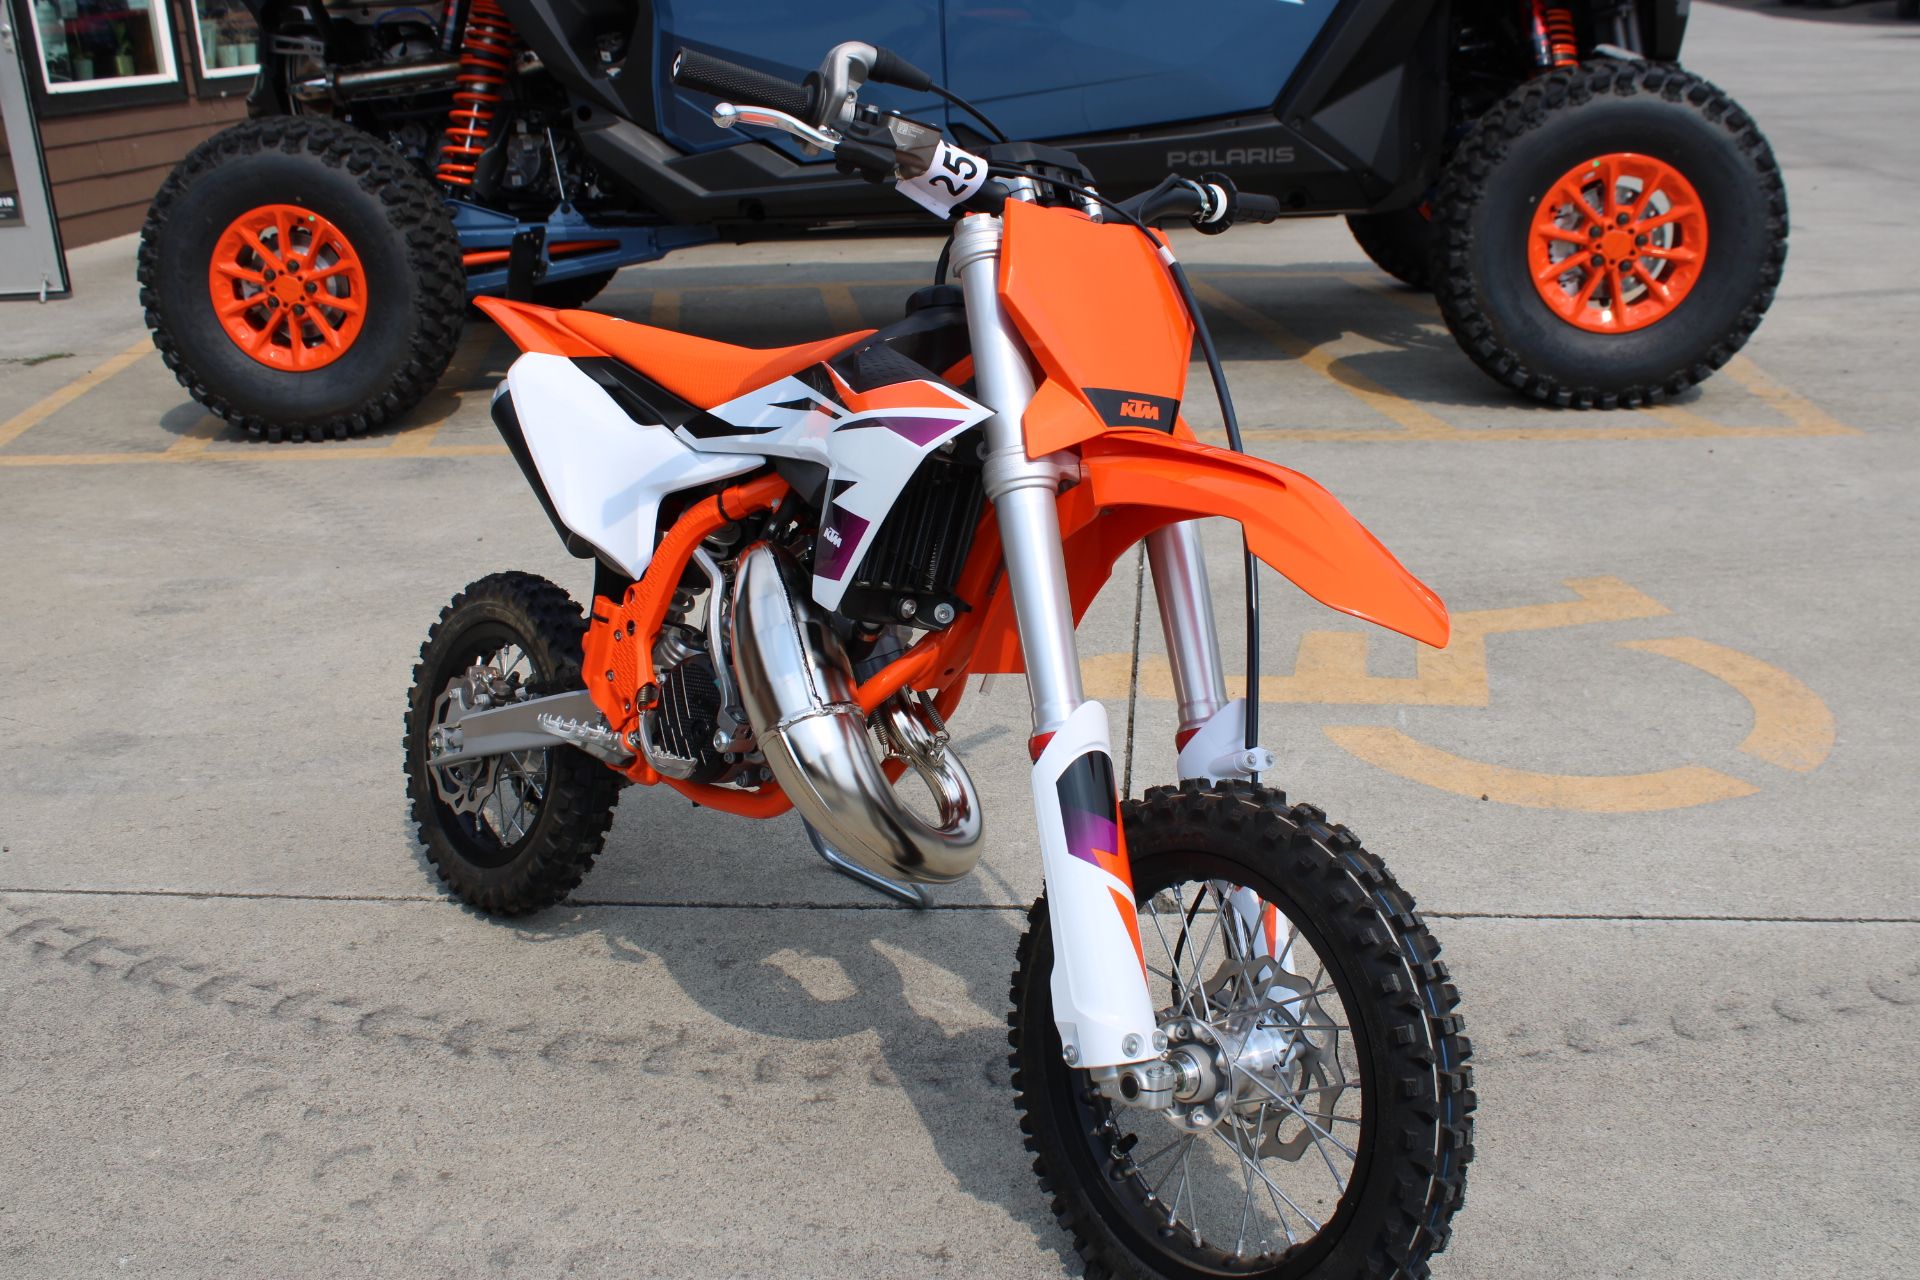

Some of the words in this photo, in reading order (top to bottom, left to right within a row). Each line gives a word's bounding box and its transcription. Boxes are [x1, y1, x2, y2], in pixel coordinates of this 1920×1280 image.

[1167, 146, 1295, 168] POLARIS
[929, 143, 977, 197] 25
[1120, 399, 1159, 421] KTM
[823, 526, 843, 549] KTM
